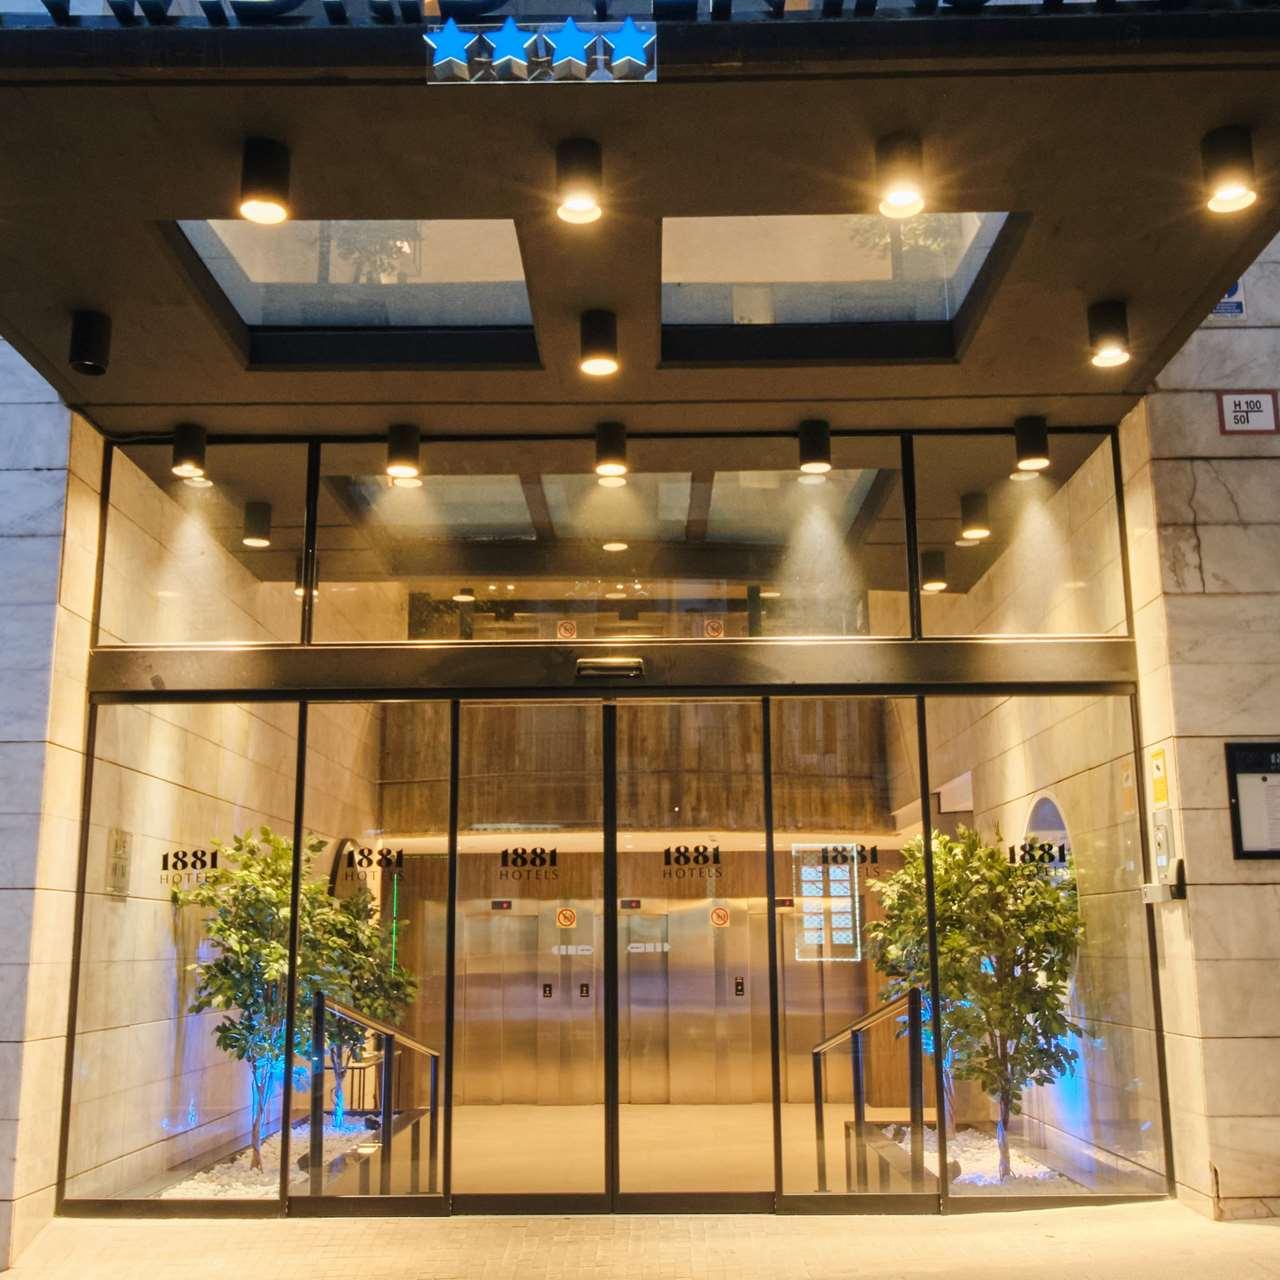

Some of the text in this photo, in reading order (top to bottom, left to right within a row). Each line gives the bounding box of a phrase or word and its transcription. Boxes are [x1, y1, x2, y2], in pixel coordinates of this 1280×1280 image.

[1233, 399, 1262, 410] H 100
[1233, 414, 1246, 425] 50
[161, 849, 218, 871] 1881
[346, 848, 404, 869] 1881
[500, 847, 558, 867] 1881
[663, 845, 720, 866] 1881
[821, 844, 879, 865] 1881
[1008, 842, 1067, 864] 1881
[499, 869, 559, 880] HOTELS
[663, 867, 722, 879] HOTELS
